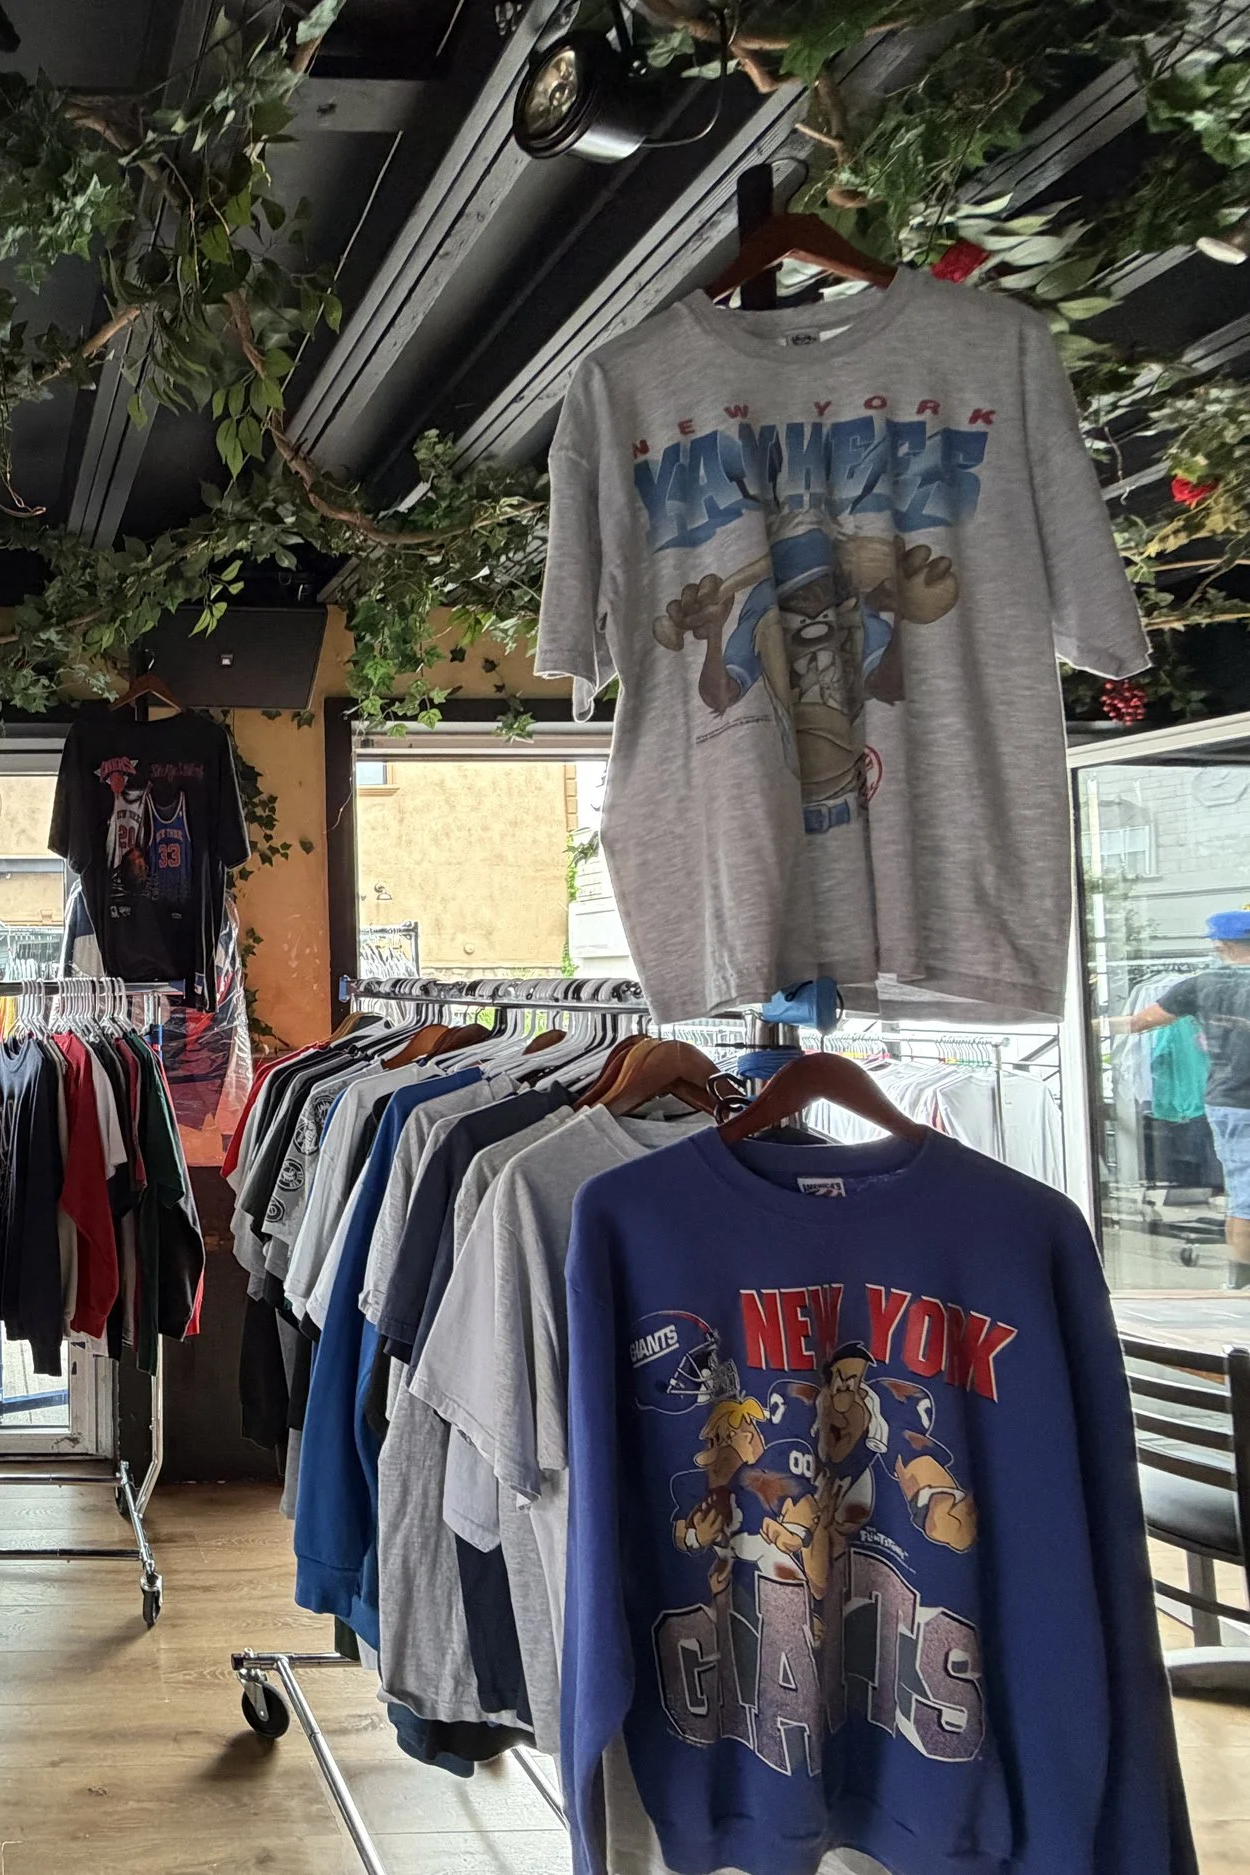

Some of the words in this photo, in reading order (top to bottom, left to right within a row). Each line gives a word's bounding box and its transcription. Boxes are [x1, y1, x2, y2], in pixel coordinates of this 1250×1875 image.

[631, 404, 750, 460] NEW
[813, 395, 998, 428] YORK
[158, 843, 181, 869] 33
[630, 1324, 678, 1362] GIANTS
